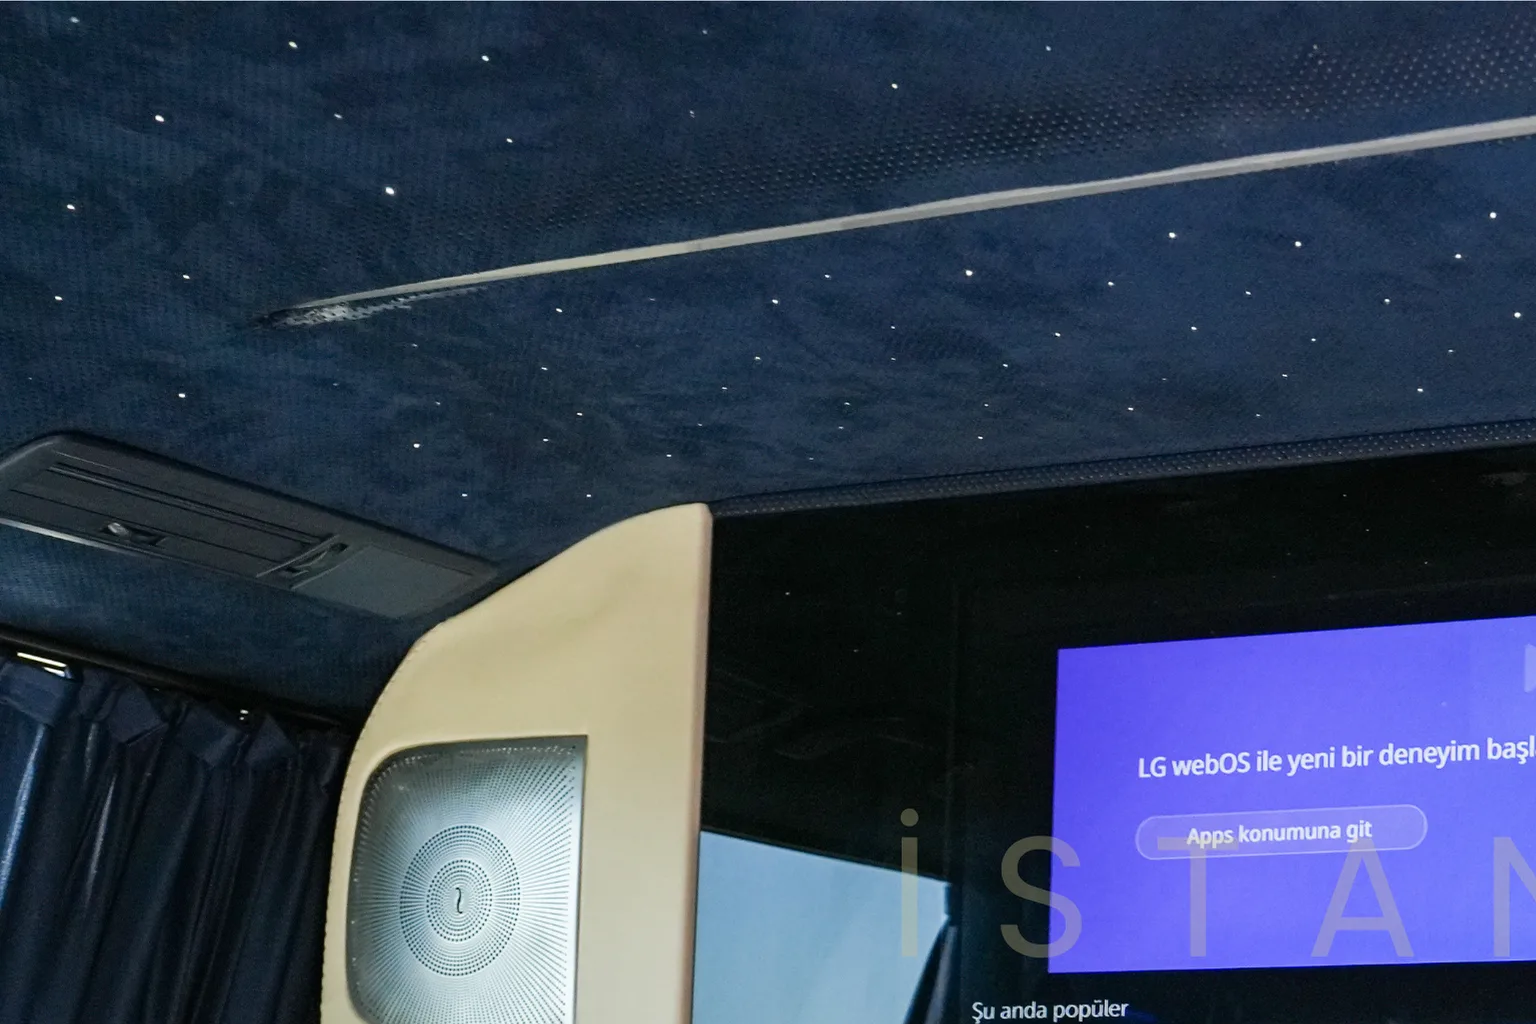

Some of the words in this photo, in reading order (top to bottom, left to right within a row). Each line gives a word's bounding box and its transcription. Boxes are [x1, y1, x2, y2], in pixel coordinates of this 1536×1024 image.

[1138, 756, 1167, 778] LG
[1172, 752, 1251, 777] webOS
[1256, 749, 1282, 773] ile
[1287, 745, 1336, 777] yeni
[1341, 744, 1375, 768] bir
[1378, 739, 1481, 769] deneyim
[1186, 827, 1234, 849] Apps
[1238, 823, 1342, 844] konumuna
[1346, 820, 1372, 844] git
[971, 1001, 996, 1024] Şu
[999, 1000, 1048, 1020] anda
[1053, 998, 1130, 1023] popüler
